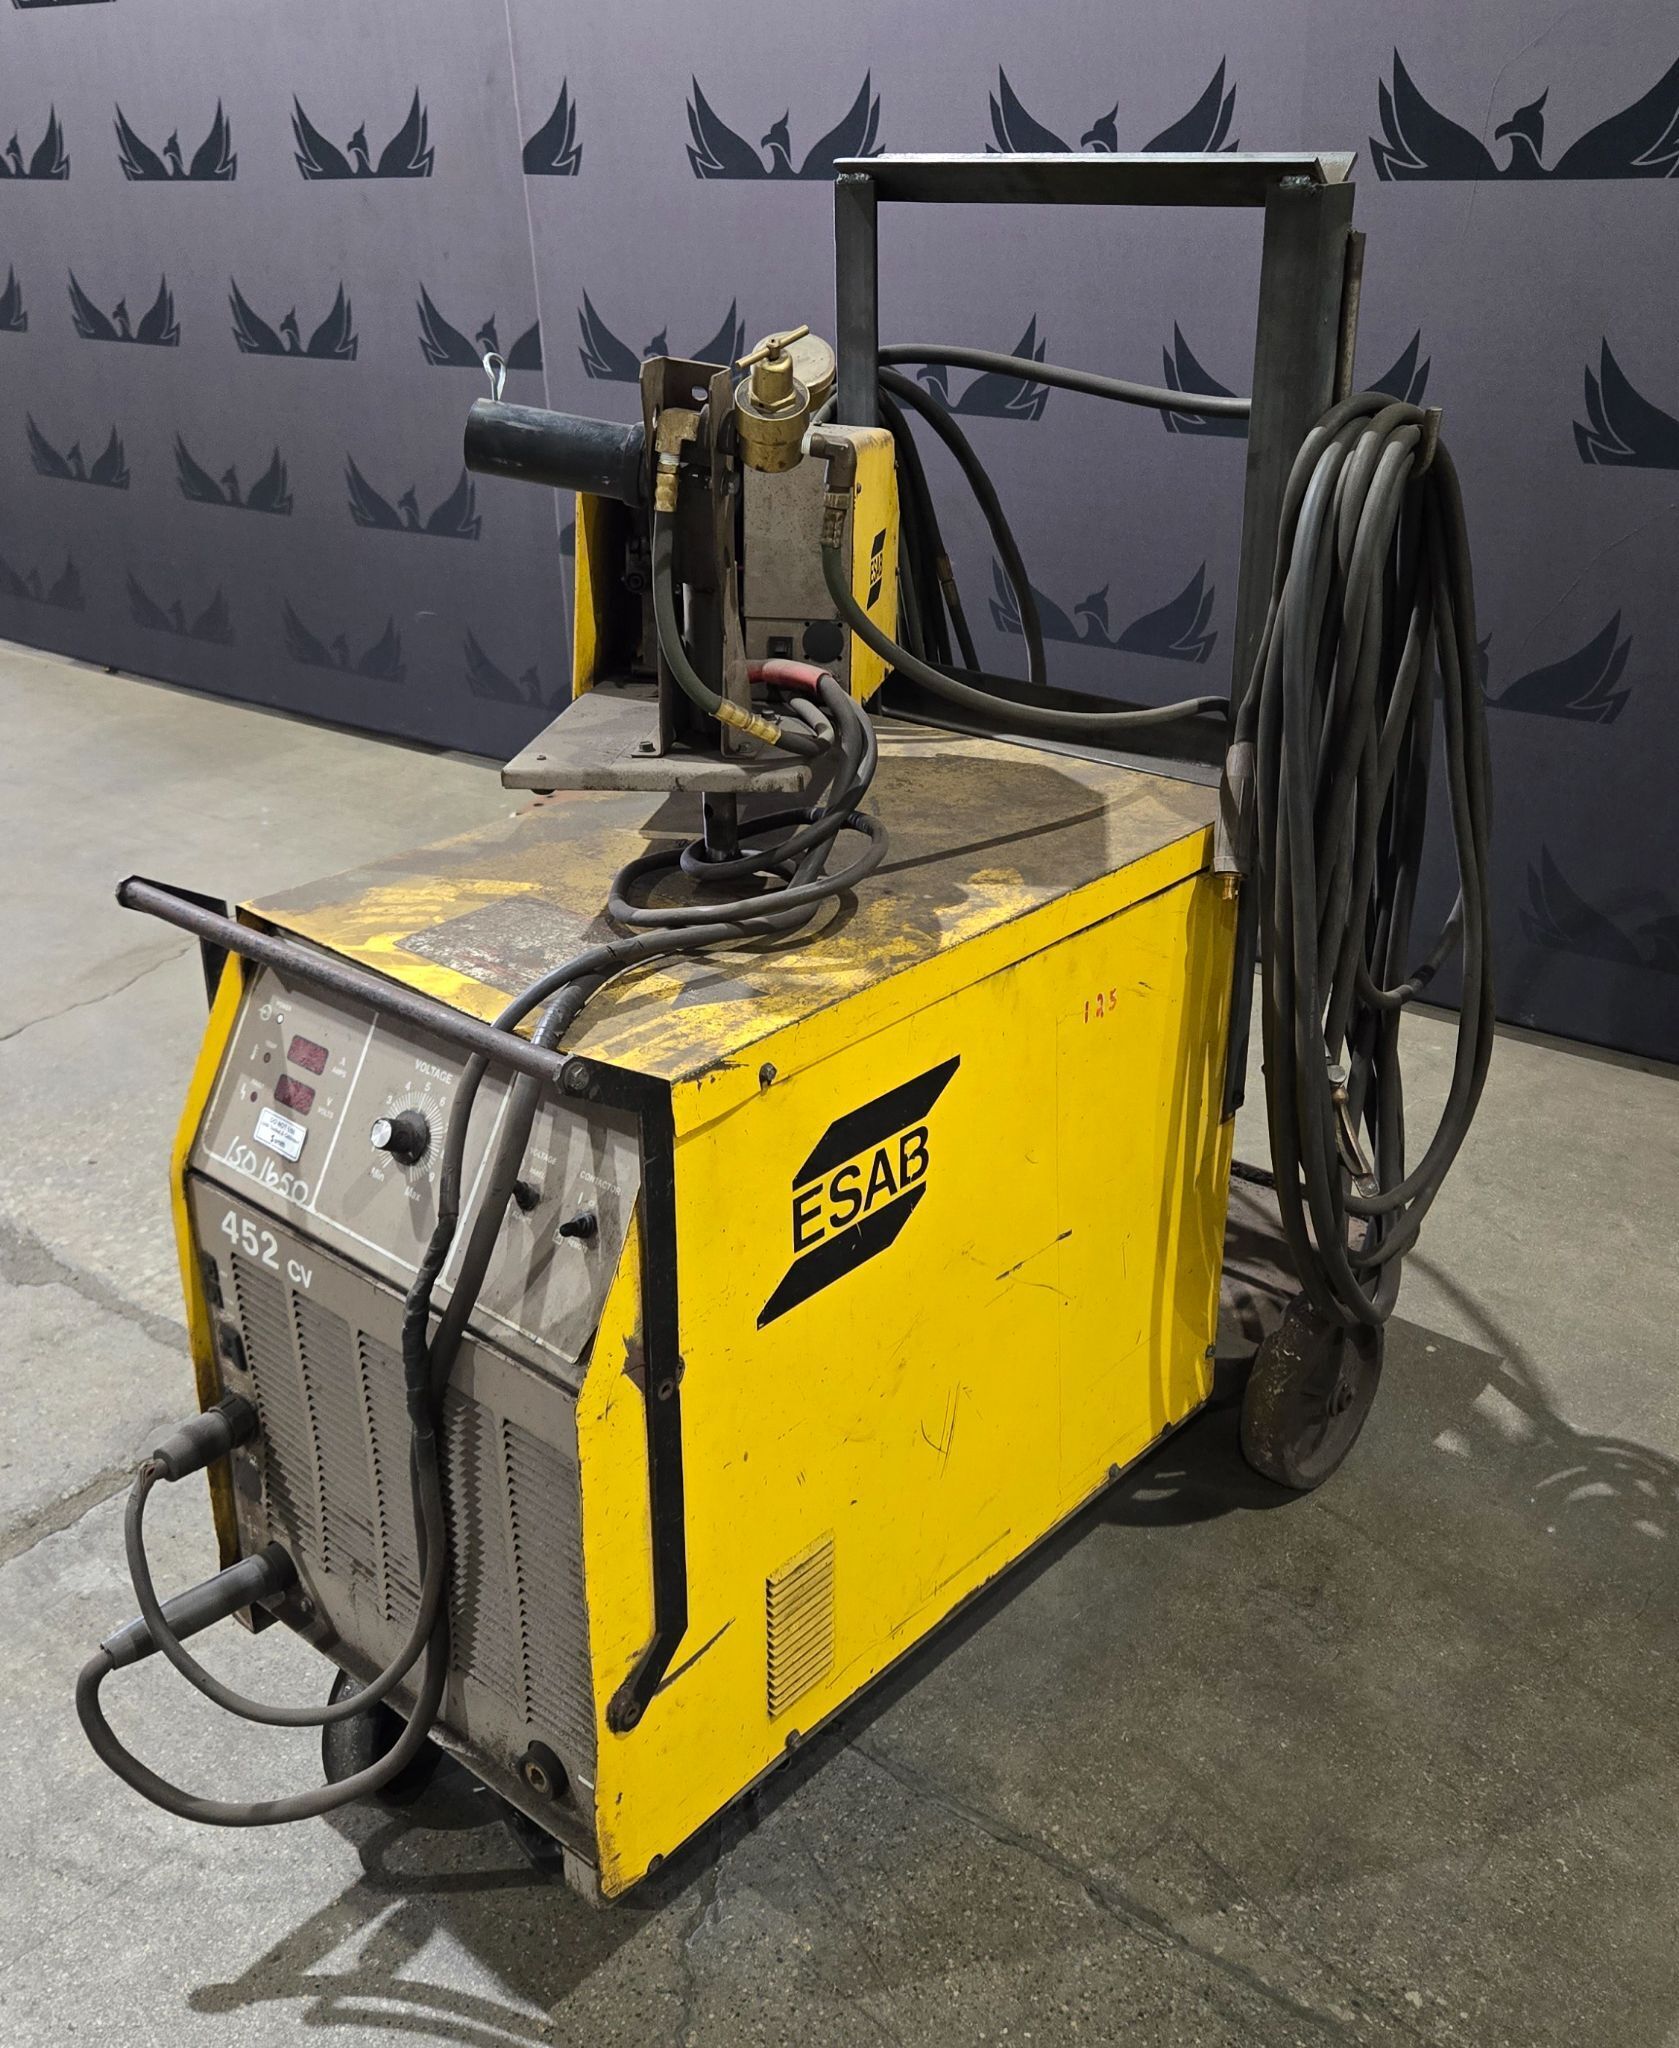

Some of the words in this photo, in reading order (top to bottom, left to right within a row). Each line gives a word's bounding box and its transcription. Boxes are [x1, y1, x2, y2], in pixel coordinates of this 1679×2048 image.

[870, 552, 883, 586] ESAB
[414, 1058, 453, 1085] VOLTAGE
[404, 1081, 412, 1091] 4
[424, 1081, 431, 1092] 5
[386, 1094, 393, 1105] 3
[439, 1095, 447, 1107] 6
[371, 1167, 385, 1182] Min
[579, 1170, 622, 1196] CONTACTOR
[793, 1125, 930, 1253] ESAB
[404, 1186, 421, 1202] Max
[221, 1210, 280, 1271] 452
[287, 1259, 313, 1289] CV
